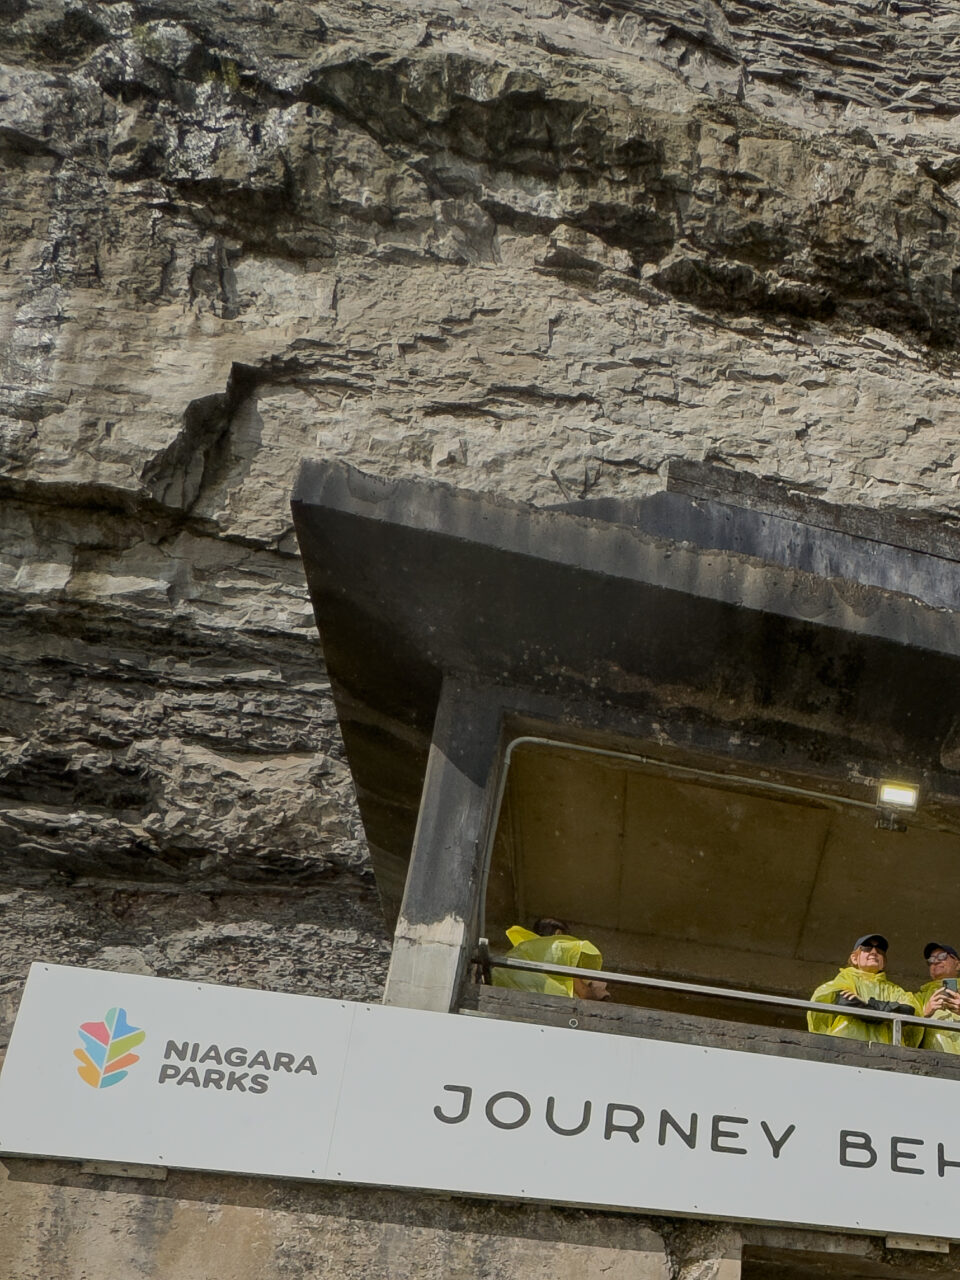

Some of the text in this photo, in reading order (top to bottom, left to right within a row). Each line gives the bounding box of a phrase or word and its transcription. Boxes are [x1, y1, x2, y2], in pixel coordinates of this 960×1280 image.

[163, 1039, 318, 1076] NIAGARA
[158, 1063, 270, 1094] PARKS
[433, 1084, 796, 1159] JOURNEY
